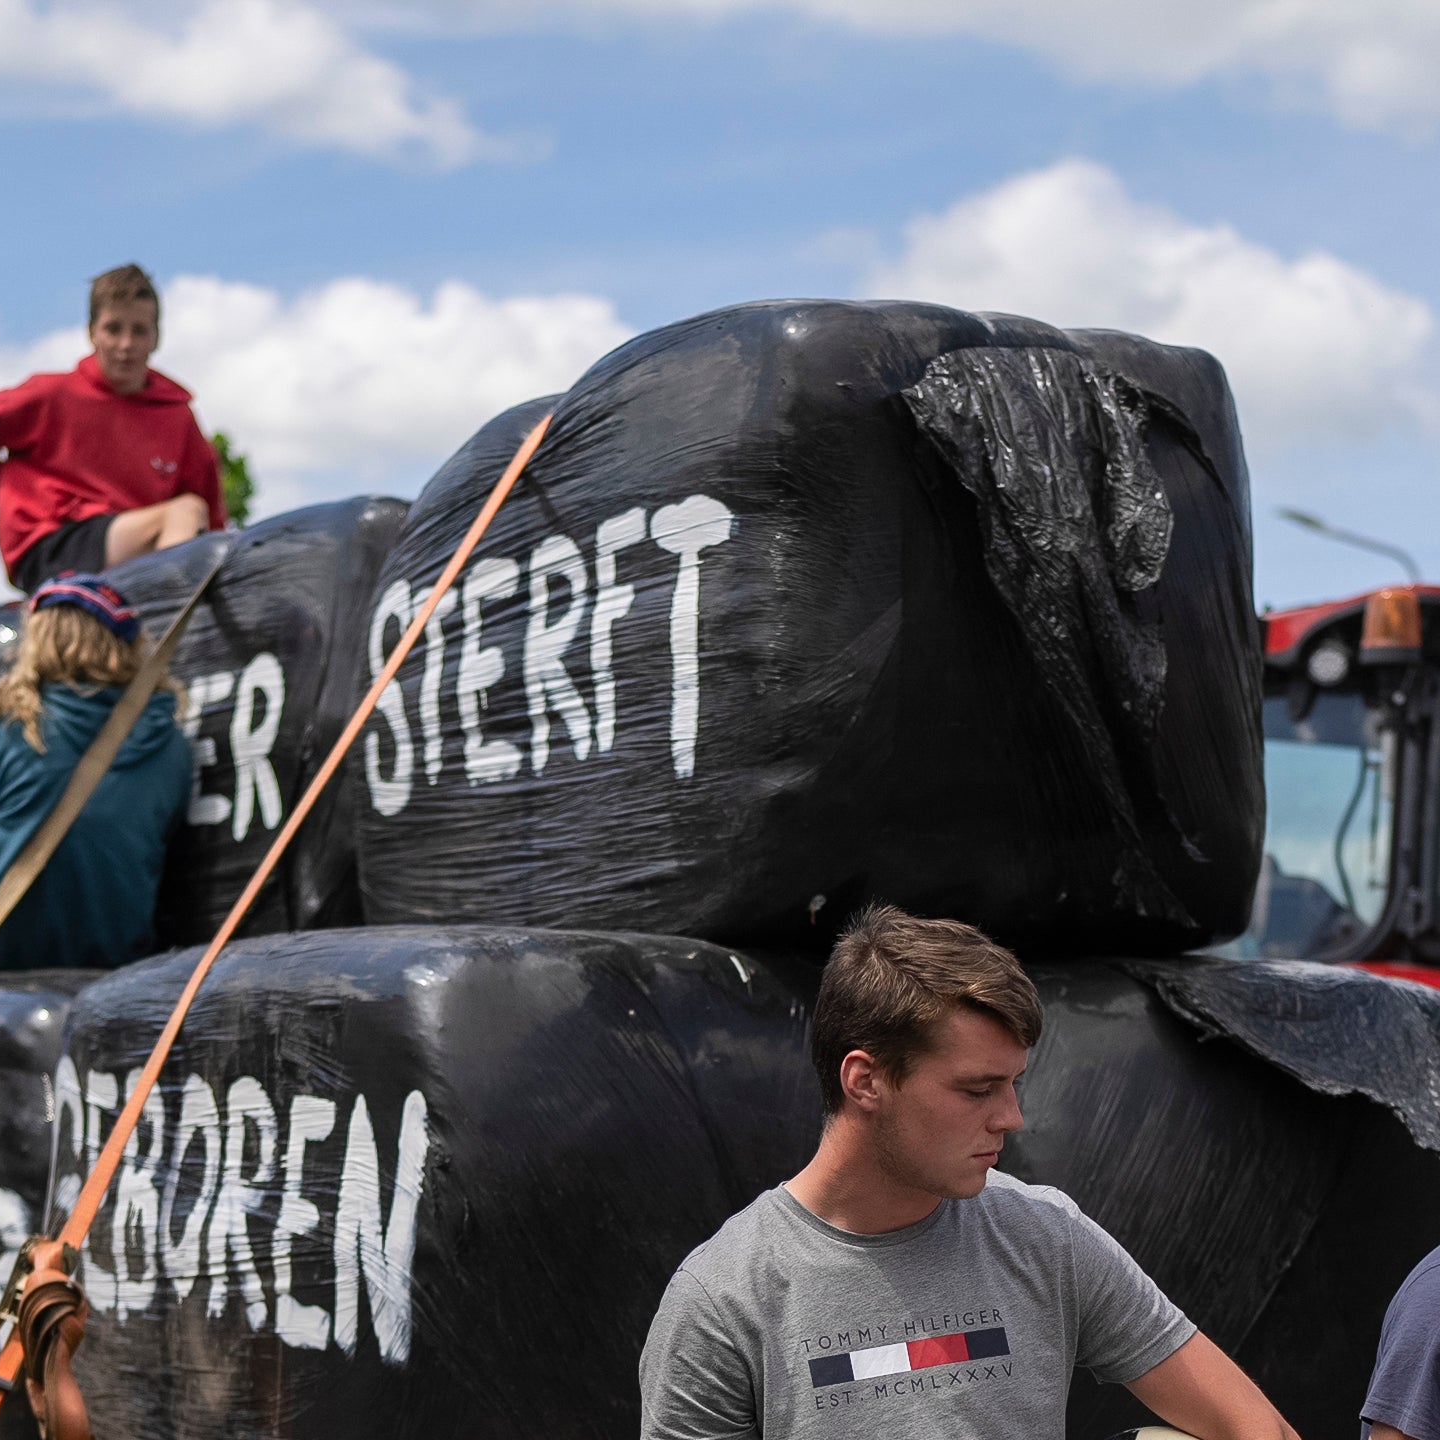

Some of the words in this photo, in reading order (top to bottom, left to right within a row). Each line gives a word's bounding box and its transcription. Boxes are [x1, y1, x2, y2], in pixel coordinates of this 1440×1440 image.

[187, 652, 285, 842] ER
[365, 494, 734, 816] STERFT
[801, 1325, 888, 1353] TOMMY
[904, 1309, 1003, 1335] HILFIGER
[815, 1391, 864, 1410] EST.
[875, 1363, 1013, 1399] MCMLXXXV
